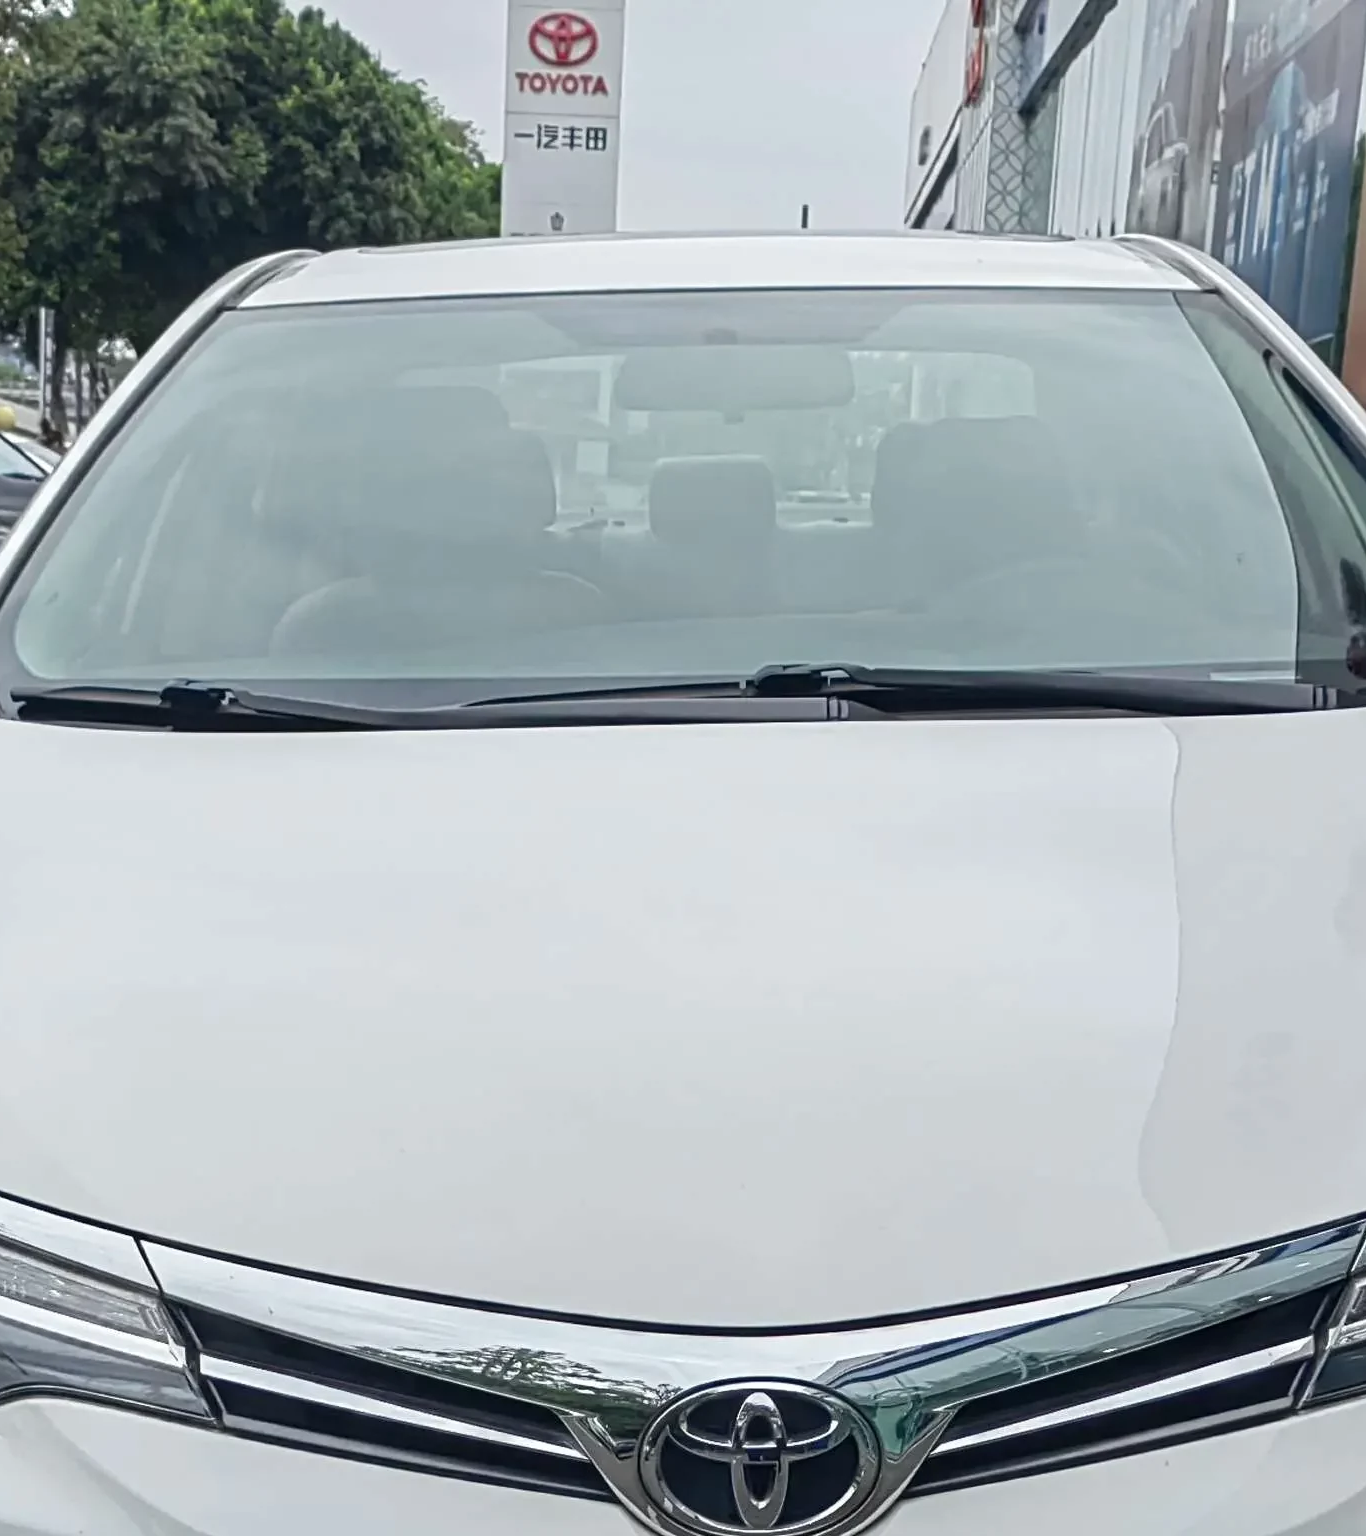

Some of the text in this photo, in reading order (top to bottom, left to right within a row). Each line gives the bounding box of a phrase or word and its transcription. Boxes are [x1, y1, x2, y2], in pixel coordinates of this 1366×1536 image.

[515, 72, 608, 97] TOYOTA
[514, 123, 607, 151] 一汽丰田
